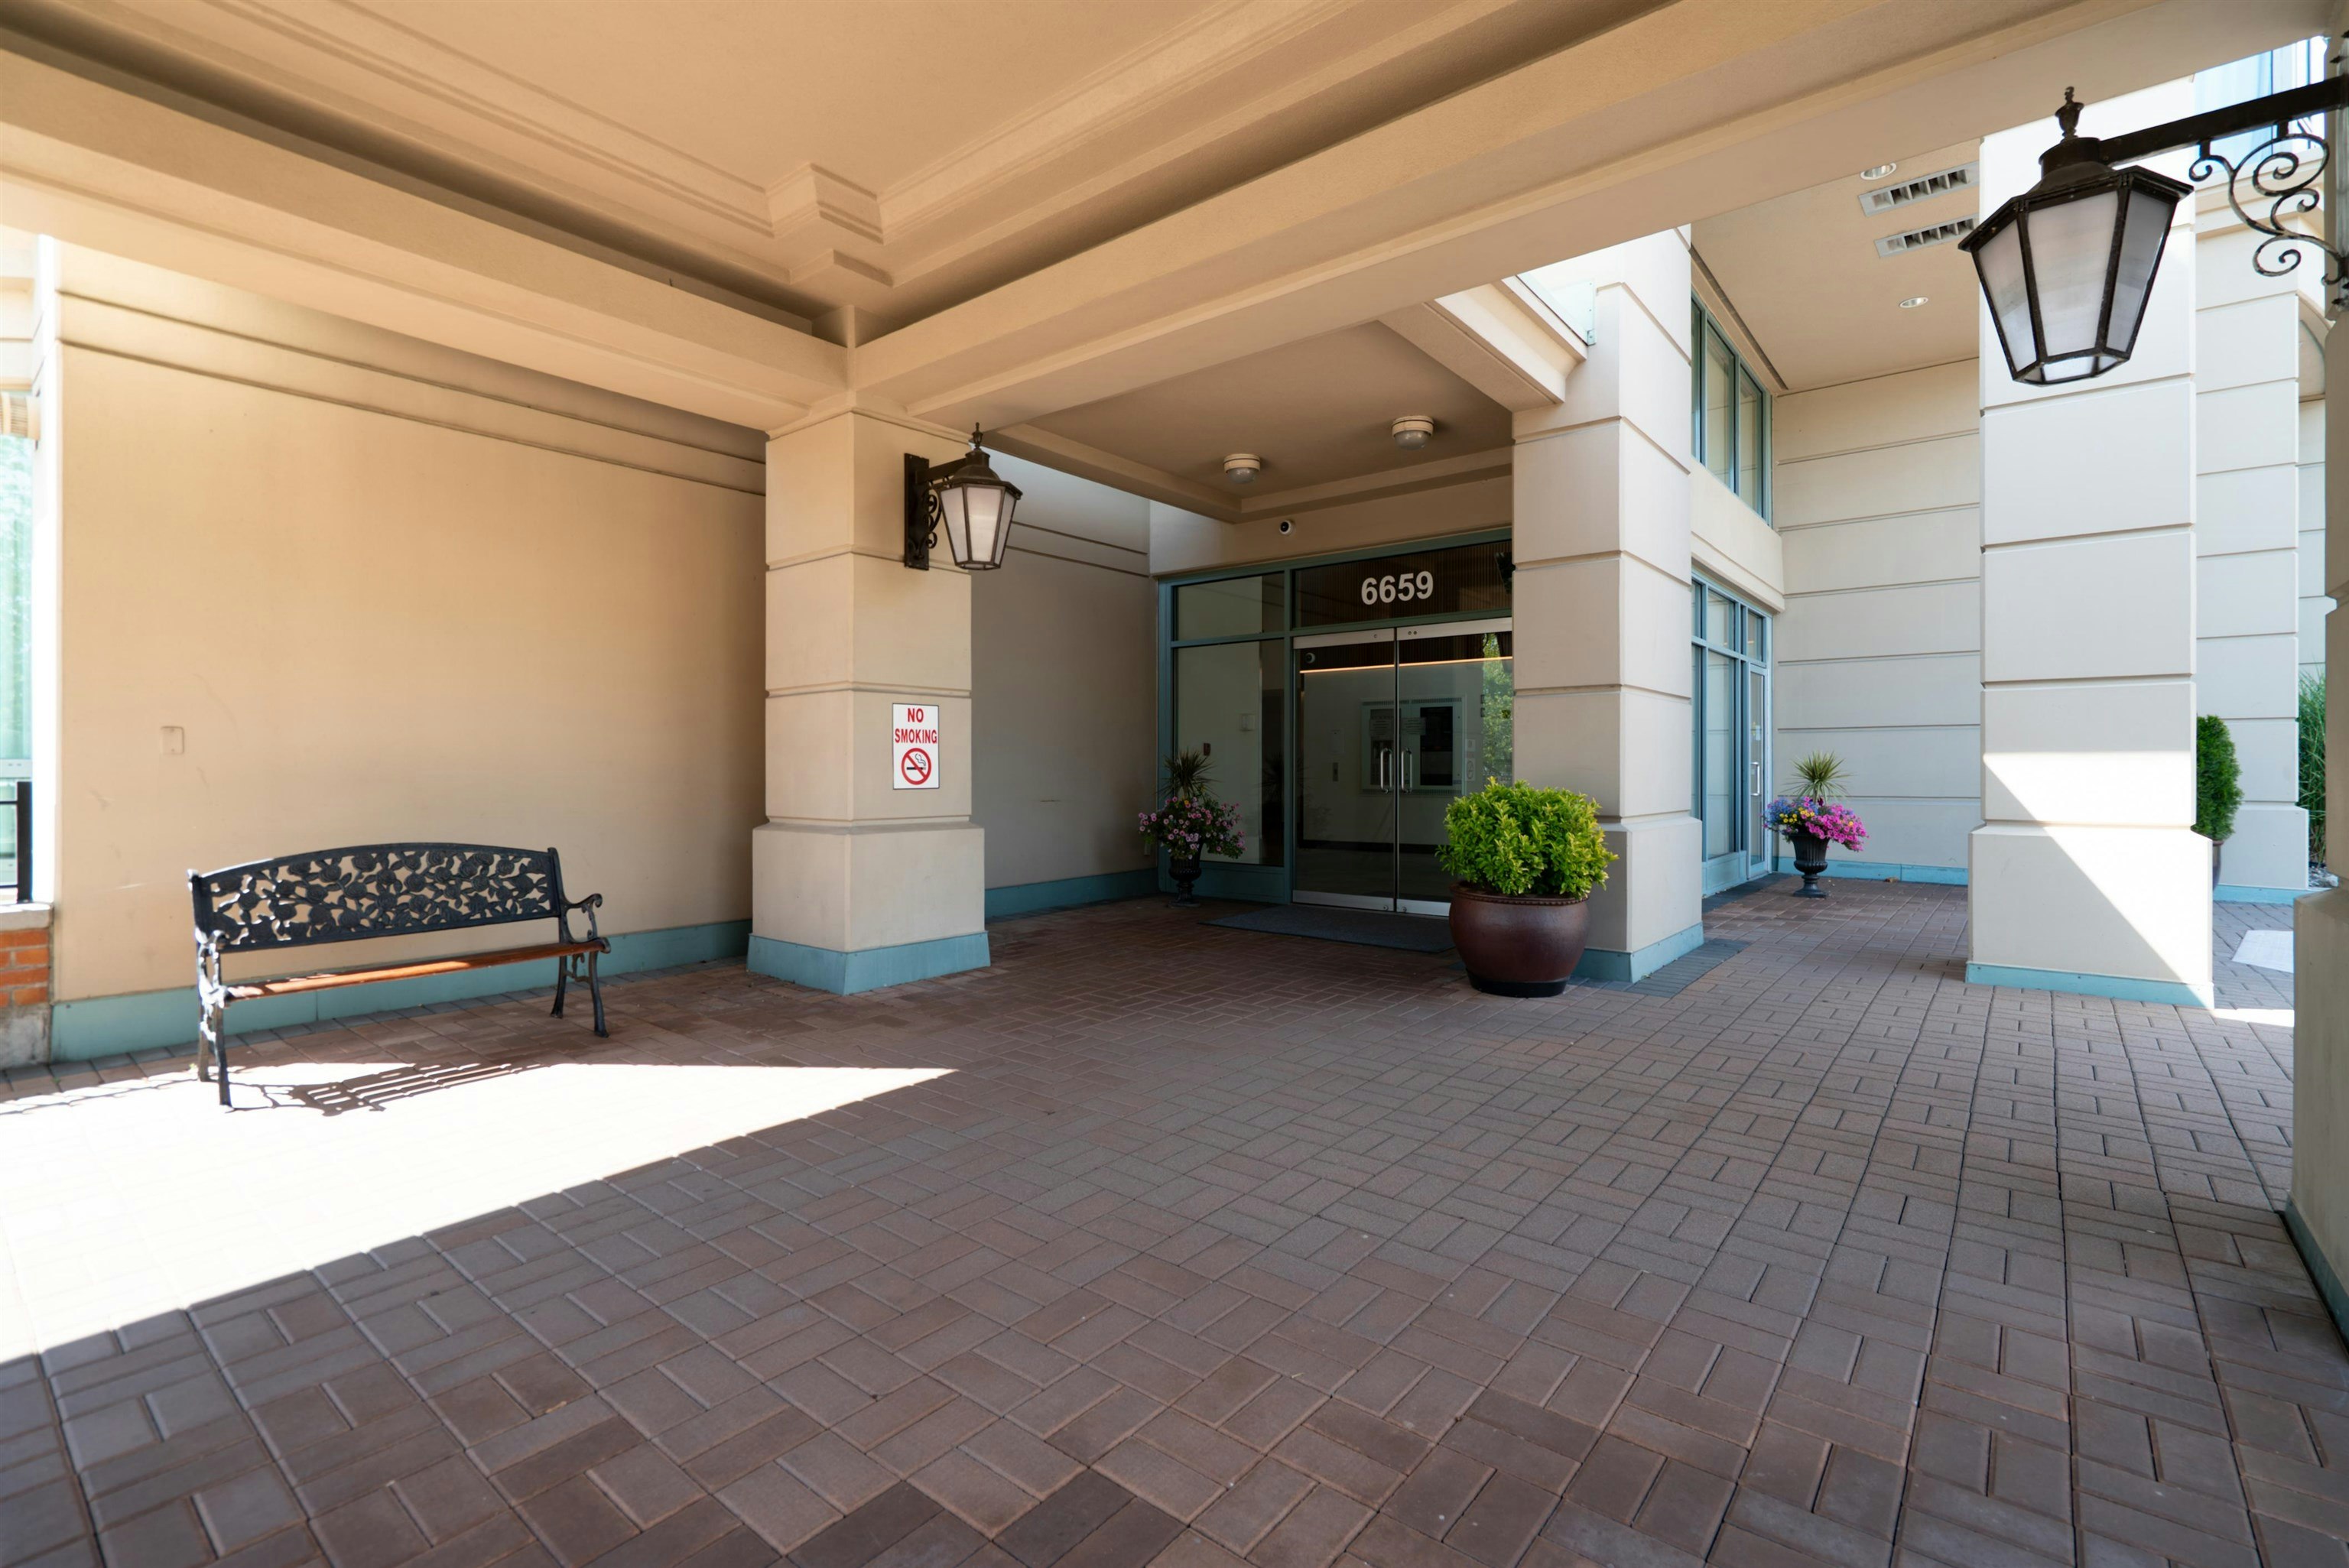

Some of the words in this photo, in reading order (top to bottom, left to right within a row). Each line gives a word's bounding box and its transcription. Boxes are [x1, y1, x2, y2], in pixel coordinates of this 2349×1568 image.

[1361, 570, 1434, 605] 6659
[907, 708, 924, 723] NO
[895, 728, 937, 744] SMOKING
